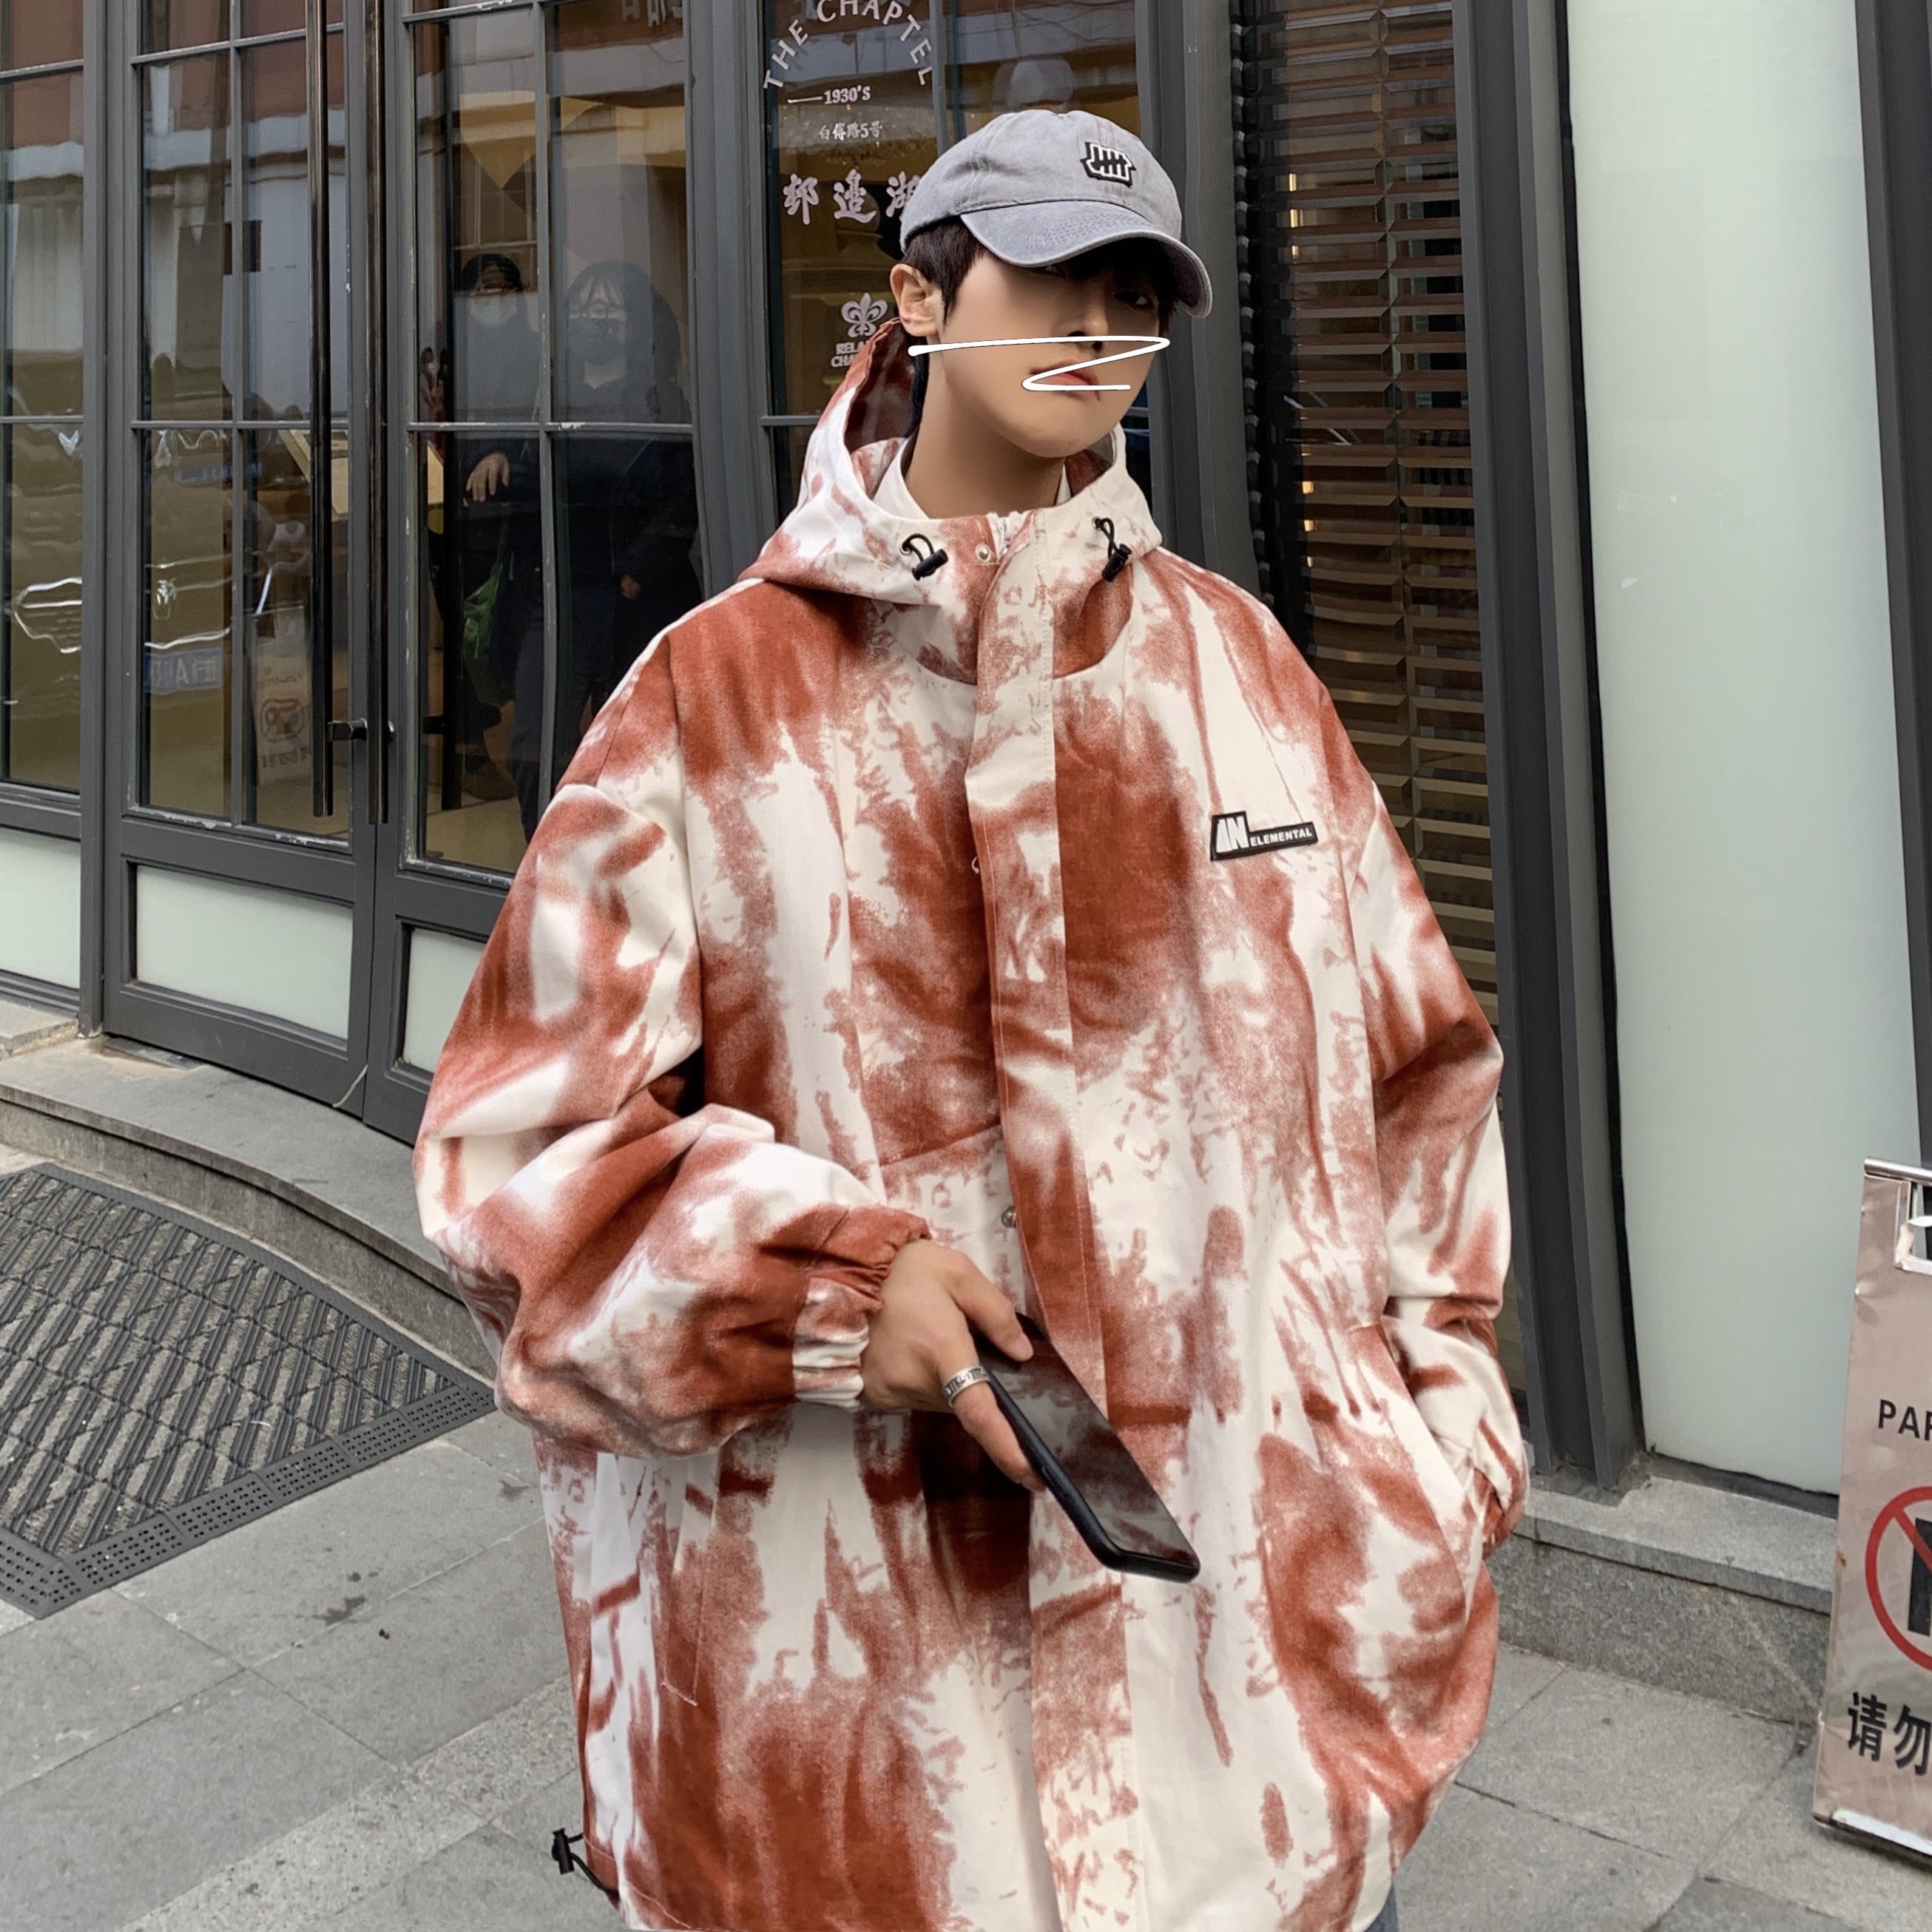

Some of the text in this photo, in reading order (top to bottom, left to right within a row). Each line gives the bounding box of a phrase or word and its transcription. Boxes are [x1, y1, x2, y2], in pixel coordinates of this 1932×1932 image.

[763, 19, 808, 89] THE
[1250, 828, 1313, 847] ELEMENTAL
[1848, 1692, 1931, 1776] 请勿
